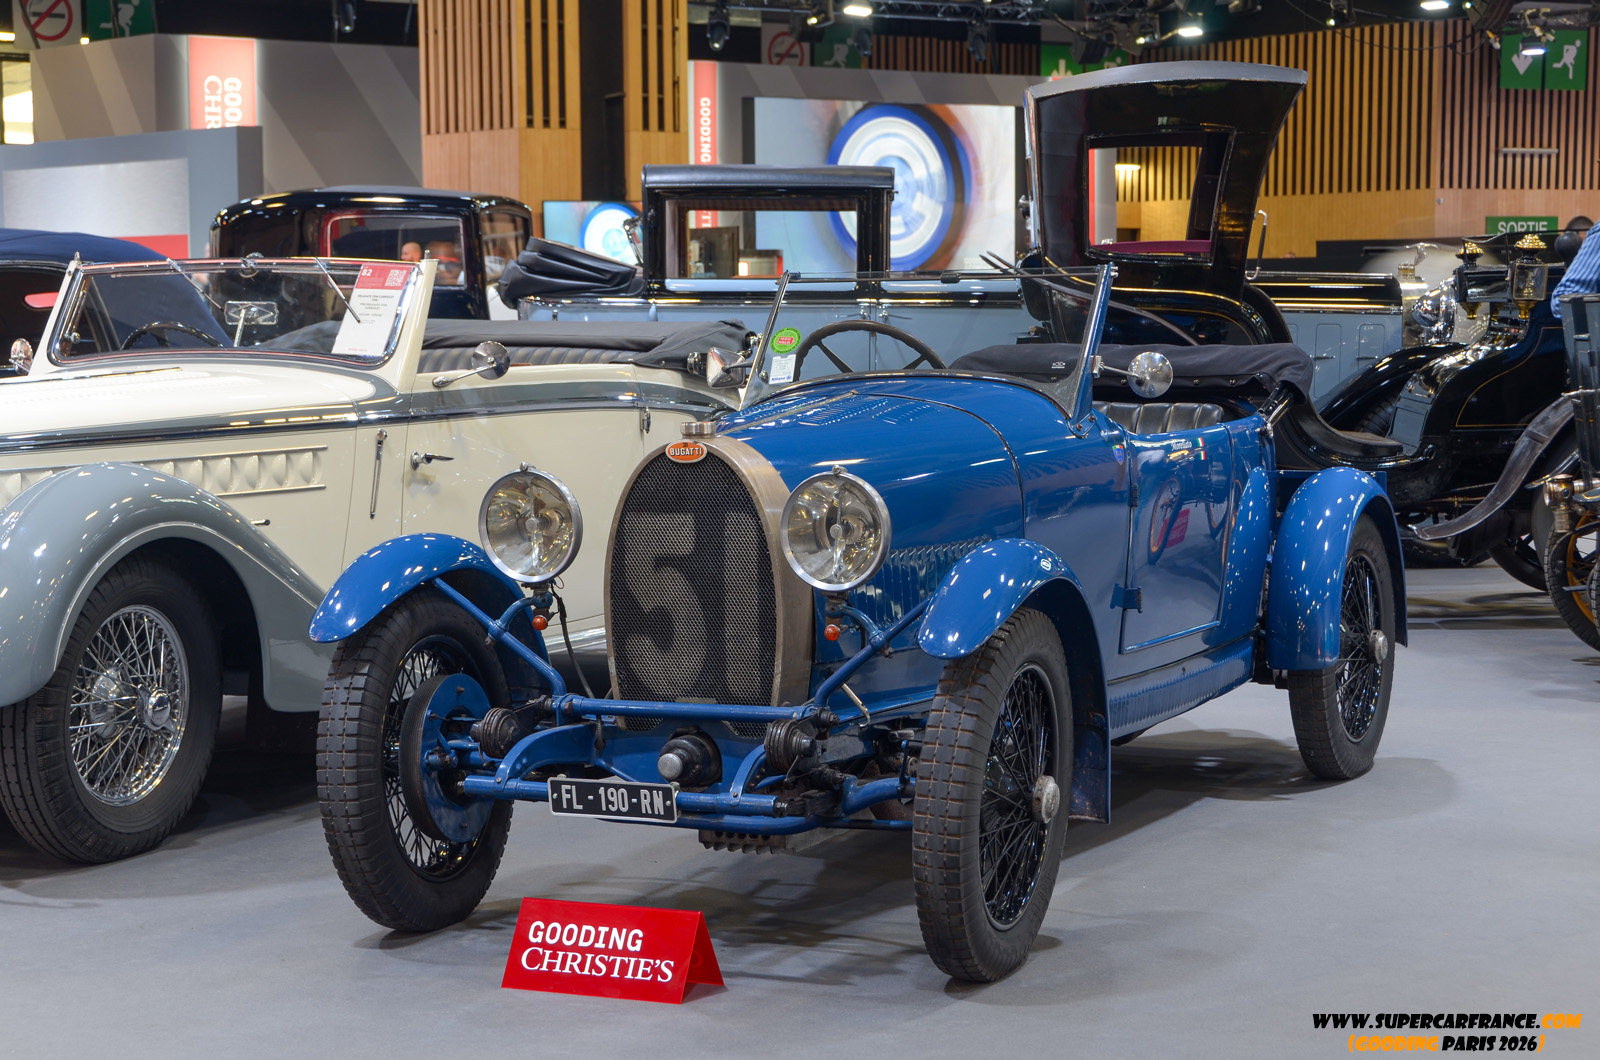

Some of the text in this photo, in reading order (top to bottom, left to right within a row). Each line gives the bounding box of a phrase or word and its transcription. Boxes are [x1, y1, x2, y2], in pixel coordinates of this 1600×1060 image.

[700, 97, 712, 163] GOODING
[361, 268, 373, 277] 82
[670, 447, 703, 456] BUGATTI
[624, 512, 762, 697] 51
[528, 920, 644, 952] GOODING
[521, 946, 675, 983] CHRISTIE'S
